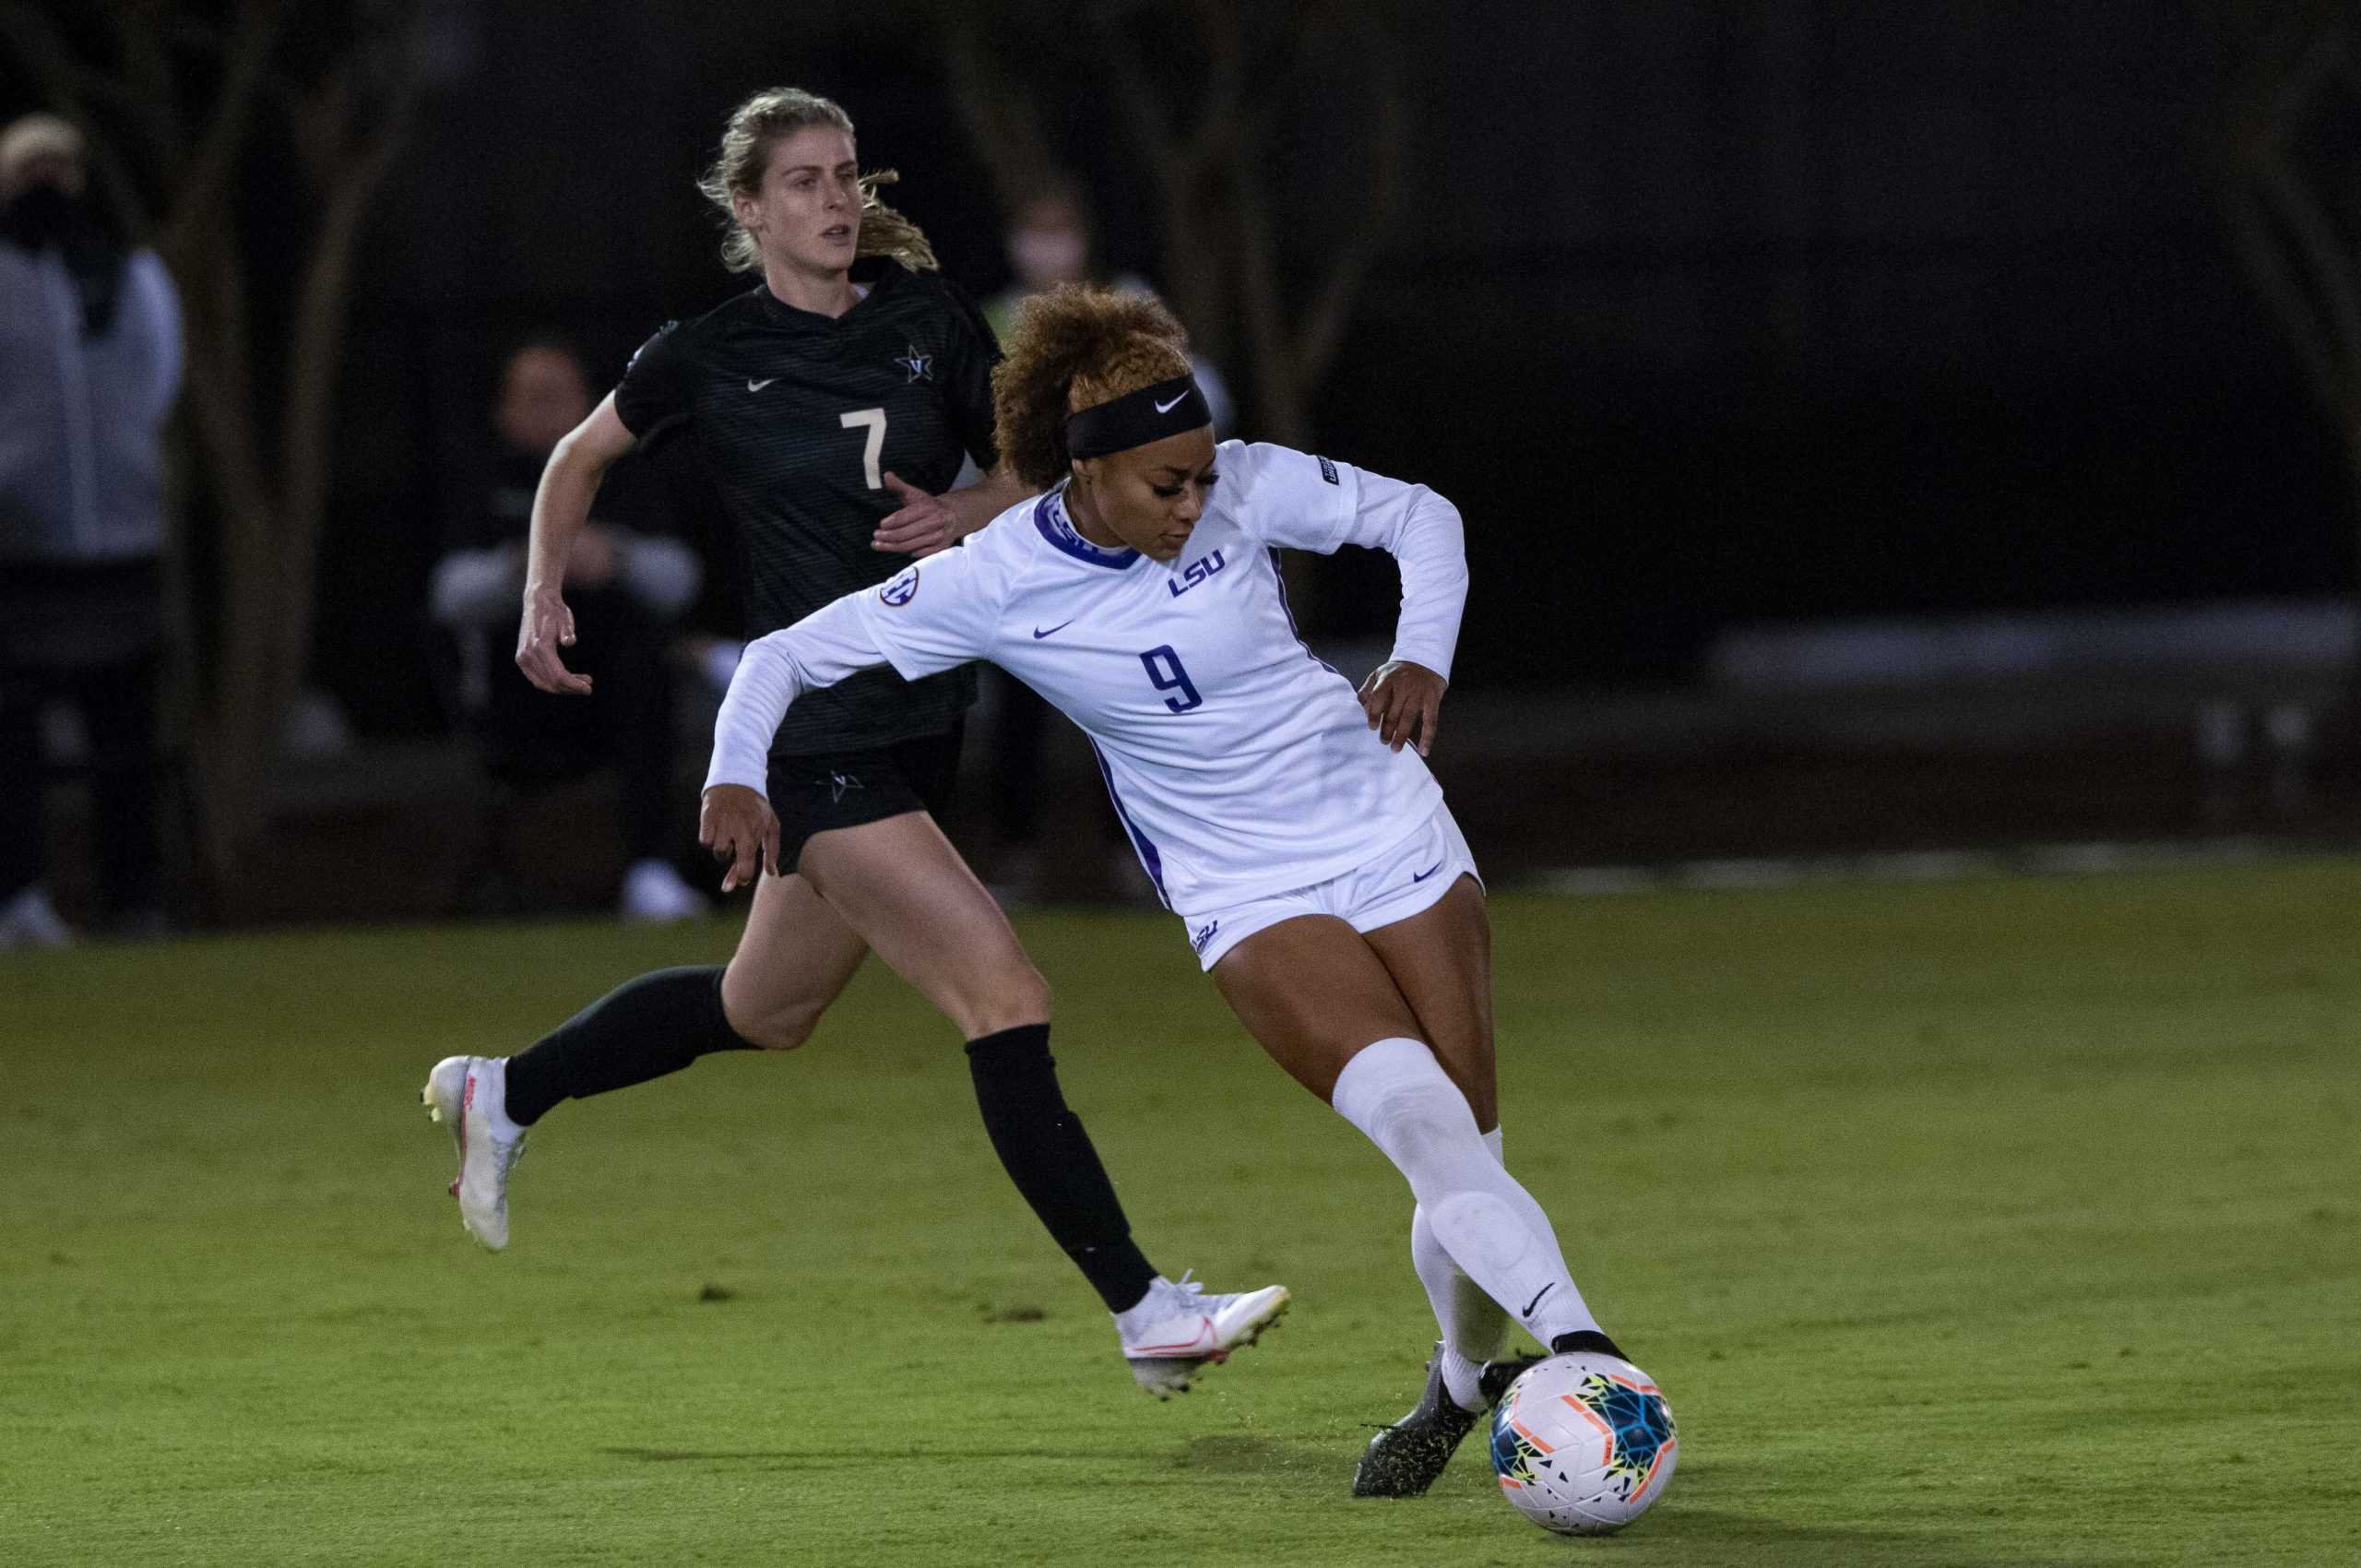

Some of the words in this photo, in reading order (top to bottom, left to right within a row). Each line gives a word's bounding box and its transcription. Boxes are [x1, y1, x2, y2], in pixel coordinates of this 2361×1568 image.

[839, 408, 887, 490] 7
[1168, 549, 1226, 598] LSU
[1139, 644, 1203, 714] 9
